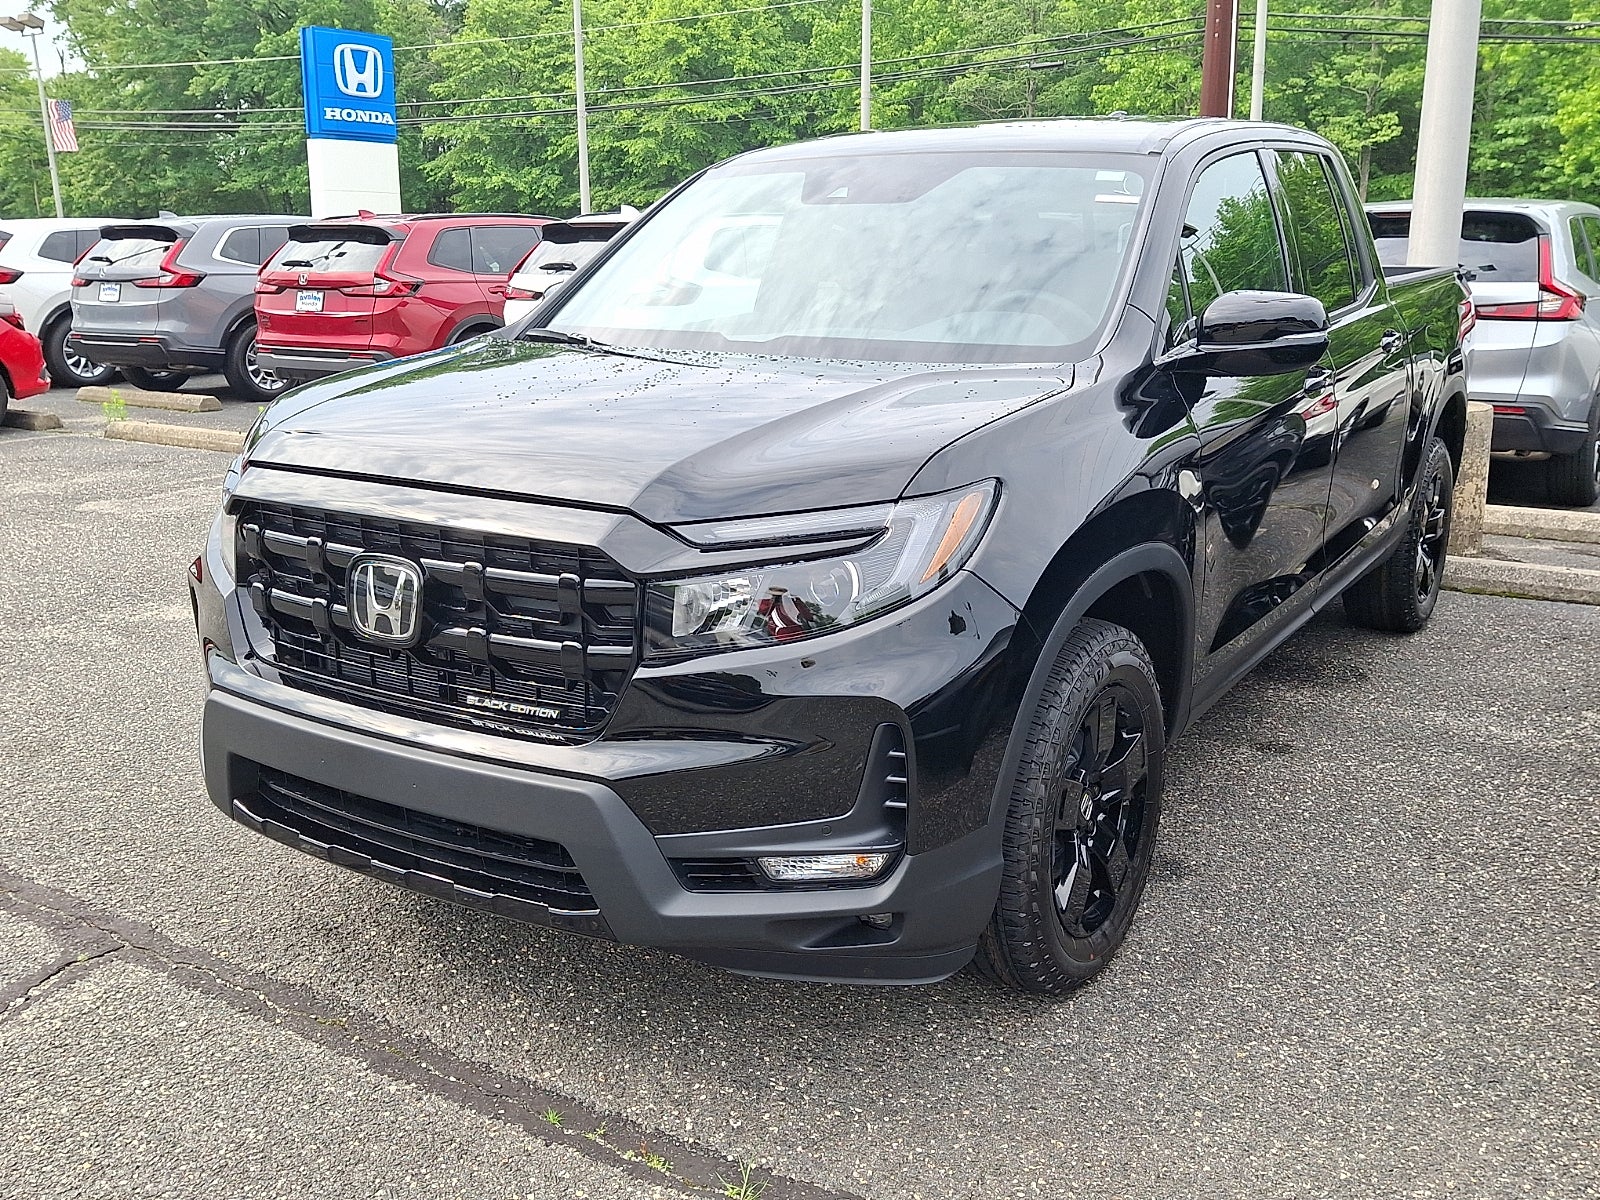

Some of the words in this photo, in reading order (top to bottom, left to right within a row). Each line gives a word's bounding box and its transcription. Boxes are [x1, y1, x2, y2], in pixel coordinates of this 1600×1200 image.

[324, 107, 395, 125] HONDA
[466, 695, 508, 711] BLACK
[509, 703, 561, 719] EDITION
